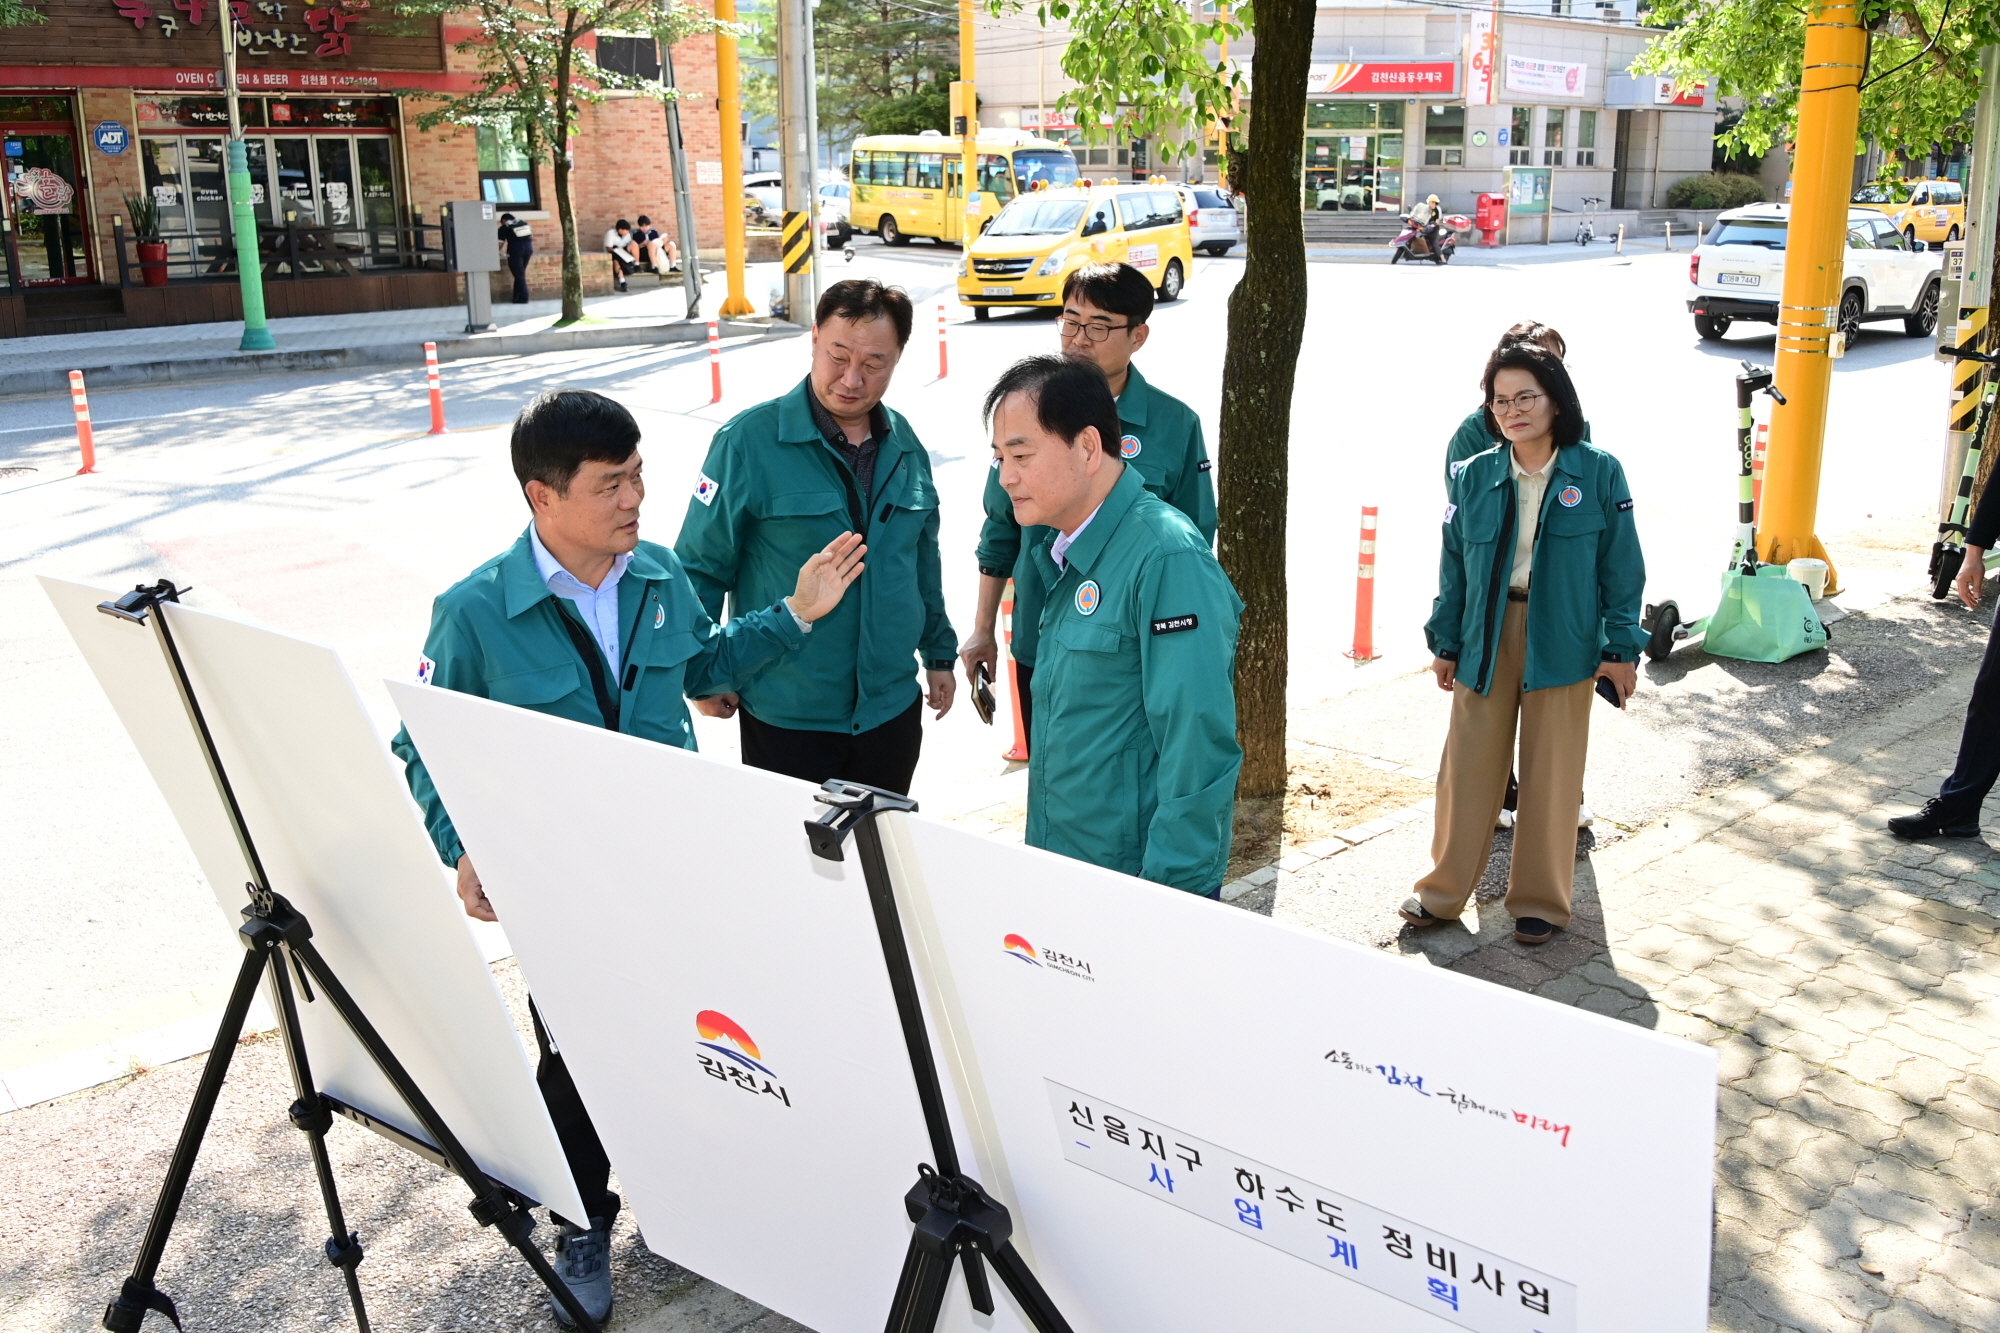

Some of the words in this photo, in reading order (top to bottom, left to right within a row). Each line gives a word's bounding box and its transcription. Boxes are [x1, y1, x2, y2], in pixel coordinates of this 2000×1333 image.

[175, 72, 204, 83] OVEN
[263, 74, 289, 84] BEER
[300, 74, 328, 86] 김천점
[1371, 71, 1442, 83] 김천신음동우체국
[100, 131, 123, 144] ADT
[1154, 622, 1167, 631] 경북
[1167, 617, 1193, 629] 김천시청
[1042, 947, 1091, 974] 김천시
[1046, 962, 1081, 978] GIMCHEON
[1081, 974, 1095, 983] CITY
[696, 1053, 792, 1108] 김천시
[1375, 1064, 1432, 1097] 김천
[1436, 1087, 1486, 1114] 함께
[1511, 1108, 1572, 1148] 미래
[1068, 1100, 1203, 1172] 신음지구
[1234, 1166, 1348, 1233] 하수도
[1382, 1224, 1550, 1316] 정비사업
